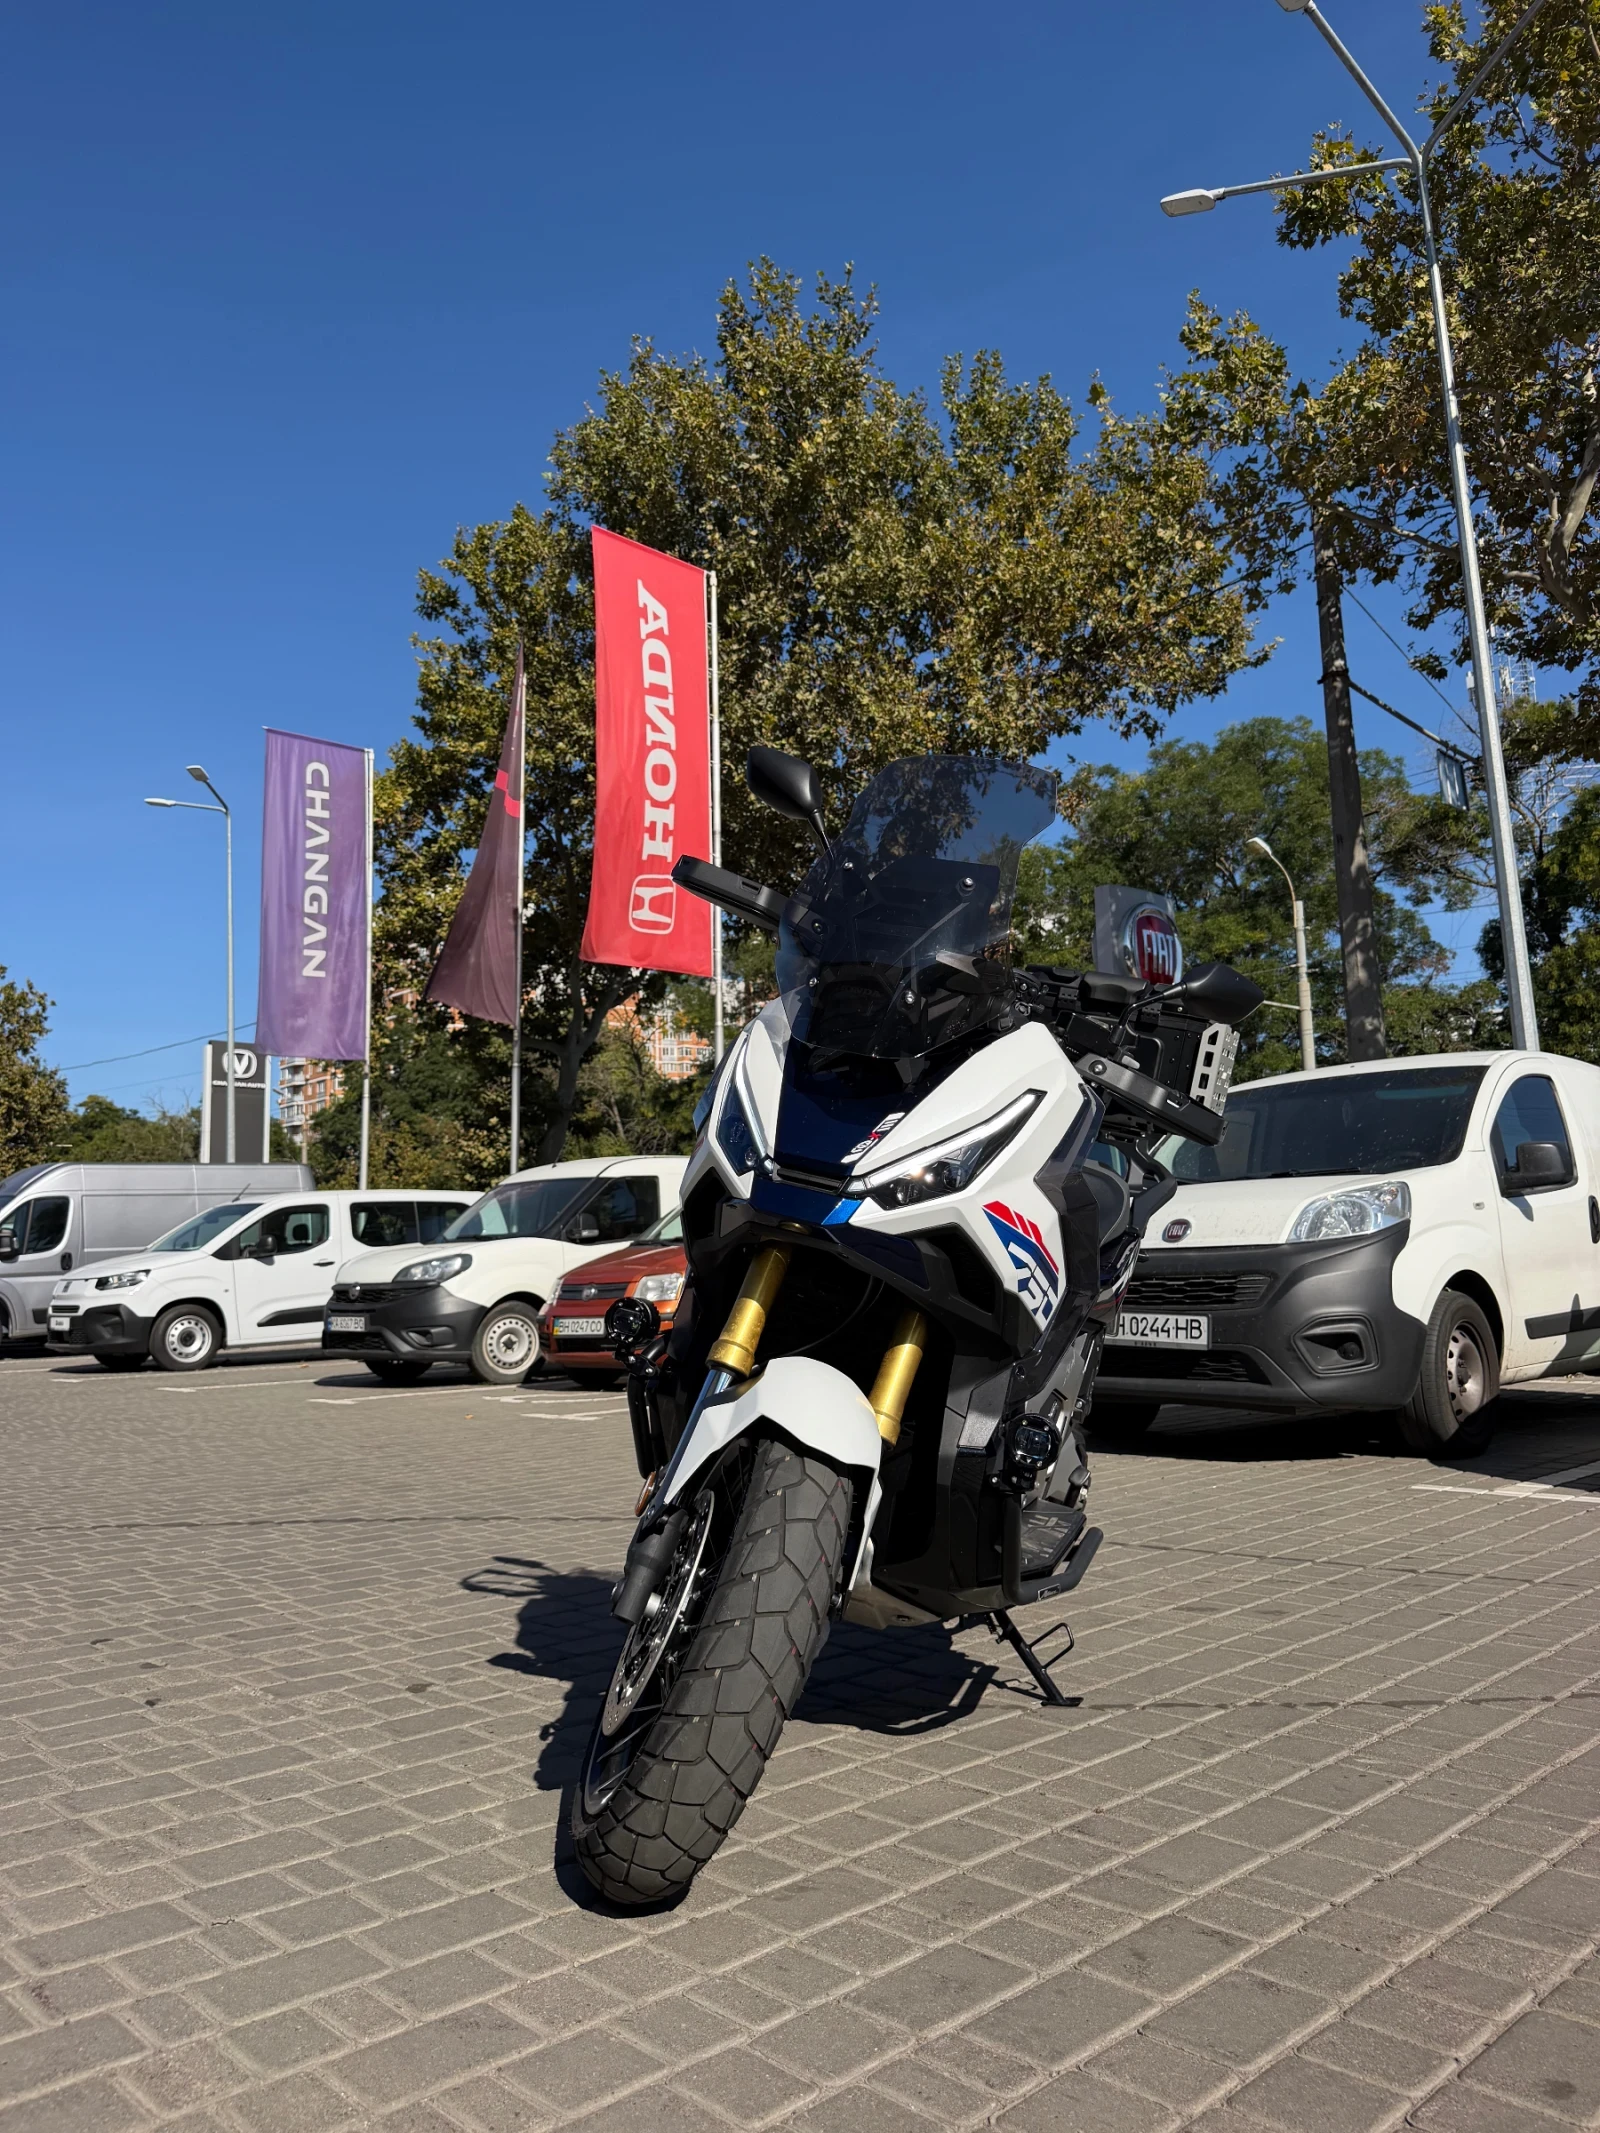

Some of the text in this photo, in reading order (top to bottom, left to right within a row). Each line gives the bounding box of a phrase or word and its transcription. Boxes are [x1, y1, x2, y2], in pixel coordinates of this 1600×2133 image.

[302, 761, 330, 977] CHANGAN
[1142, 929, 1175, 976] FIAT
[1168, 1223, 1187, 1237] FIAT
[571, 1321, 589, 1333] 0247
[1119, 1316, 1203, 1339] H 0244 HB
